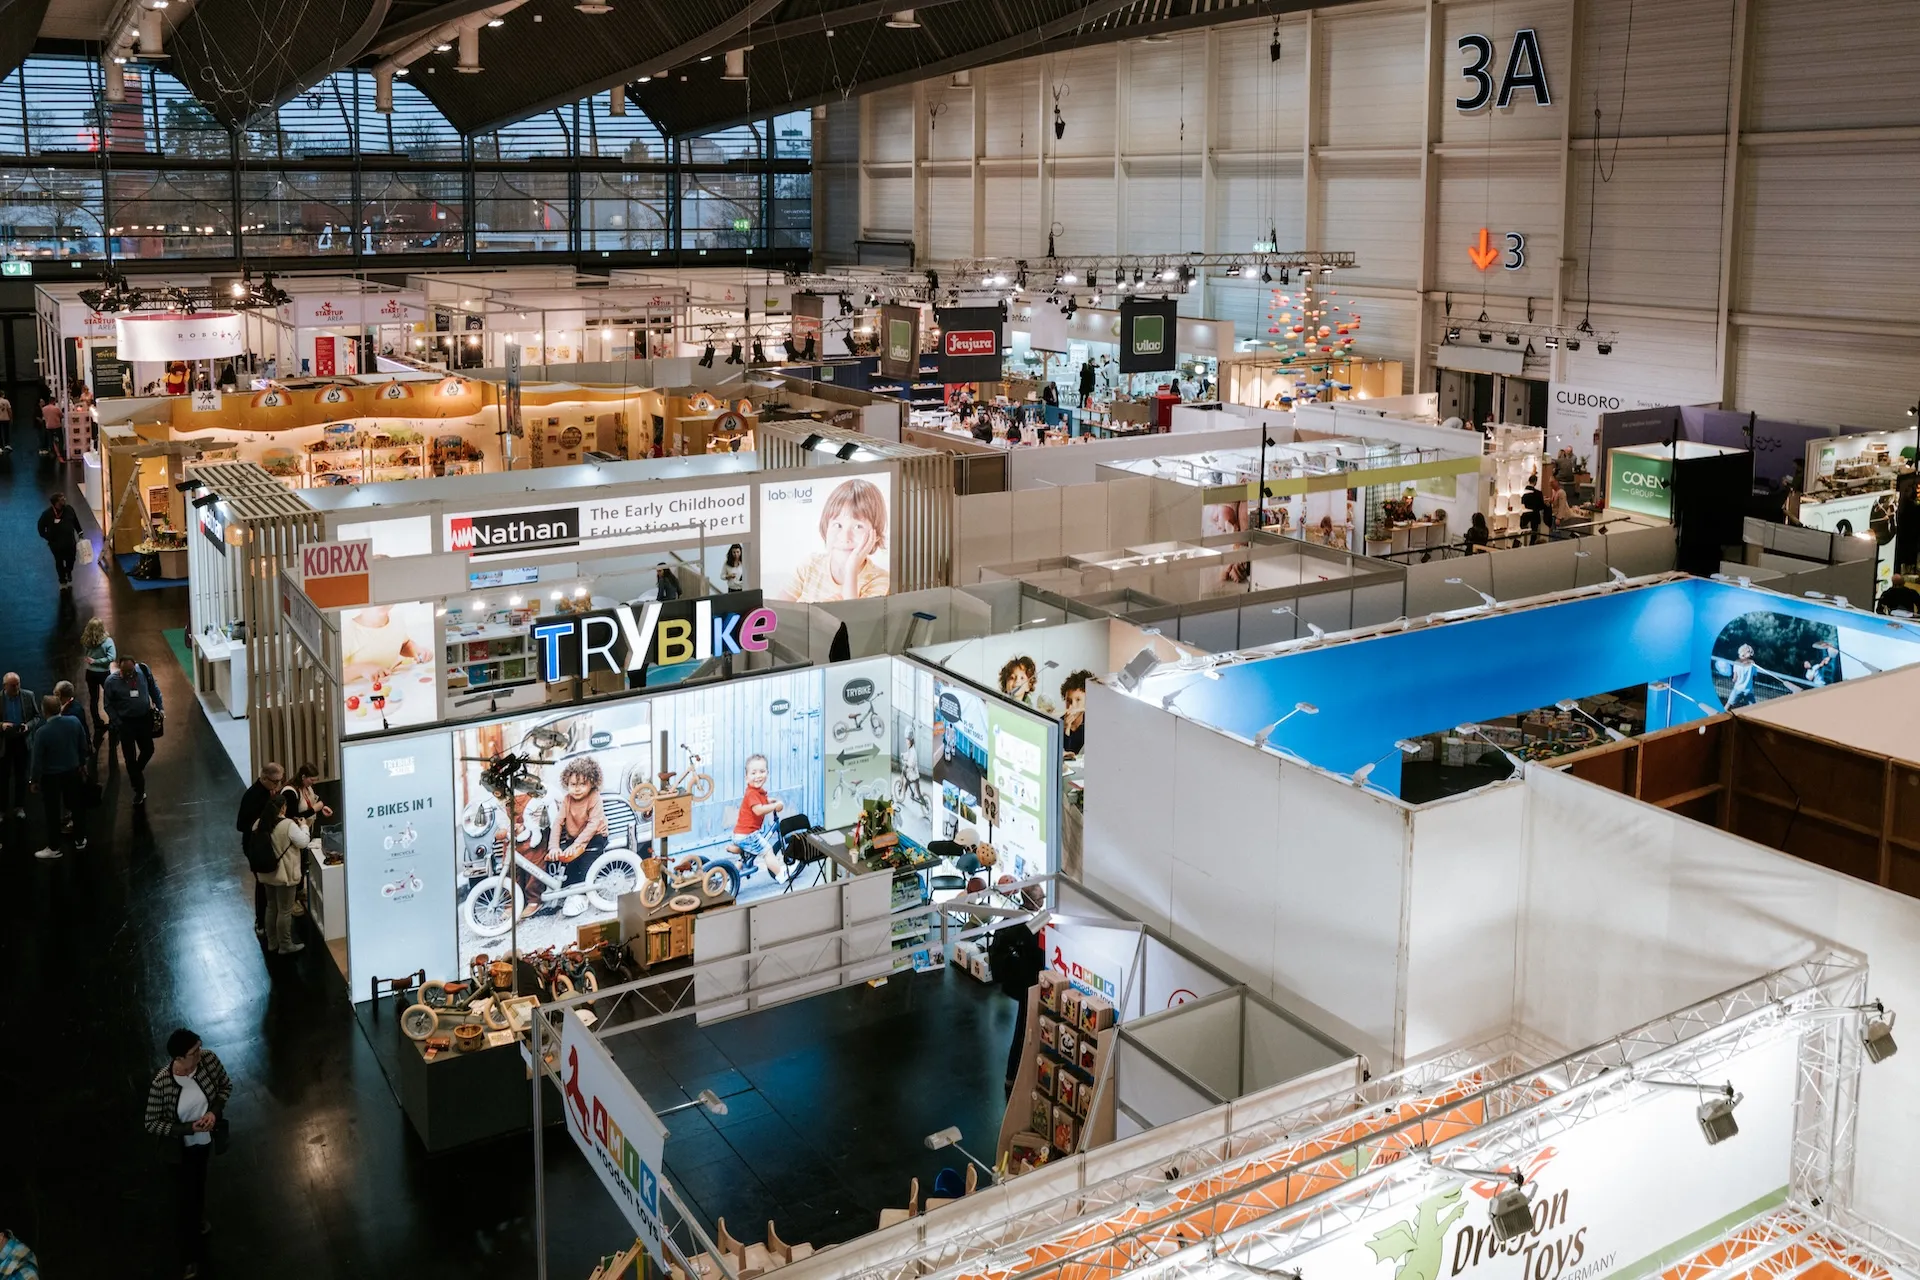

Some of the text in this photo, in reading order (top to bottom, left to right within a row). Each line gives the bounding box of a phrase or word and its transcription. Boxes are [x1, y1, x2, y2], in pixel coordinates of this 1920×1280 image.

[1455, 29, 1551, 111] 3A
[1504, 231, 1525, 272] 3
[315, 309, 344, 318] STARTUP
[380, 307, 408, 315] STARTP
[890, 343, 910, 359] vilac
[949, 333, 992, 352] Jeujura
[1135, 339, 1162, 352] vilac
[1621, 470, 1665, 490] CONEN
[1630, 487, 1655, 499] GROUP
[590, 493, 746, 521] The Early Childhood
[688, 513, 745, 533] Expert
[471, 520, 568, 547] Nathan
[303, 542, 369, 577] KORXX
[845, 684, 872, 699] TRYBIKE
[771, 702, 789, 712] TRYBIKE
[590, 734, 611, 745] TRYBIKE
[383, 756, 415, 769] TRYBIKE
[367, 797, 433, 819] 2 BIKES IN 1
[391, 849, 415, 858] TRICYCLE
[393, 893, 415, 902] BICYCLE
[1072, 979, 1098, 998] wooden
[1073, 963, 1115, 998] AMIK
[593, 1100, 656, 1212] AMIK
[595, 1140, 660, 1243] wooden toys
